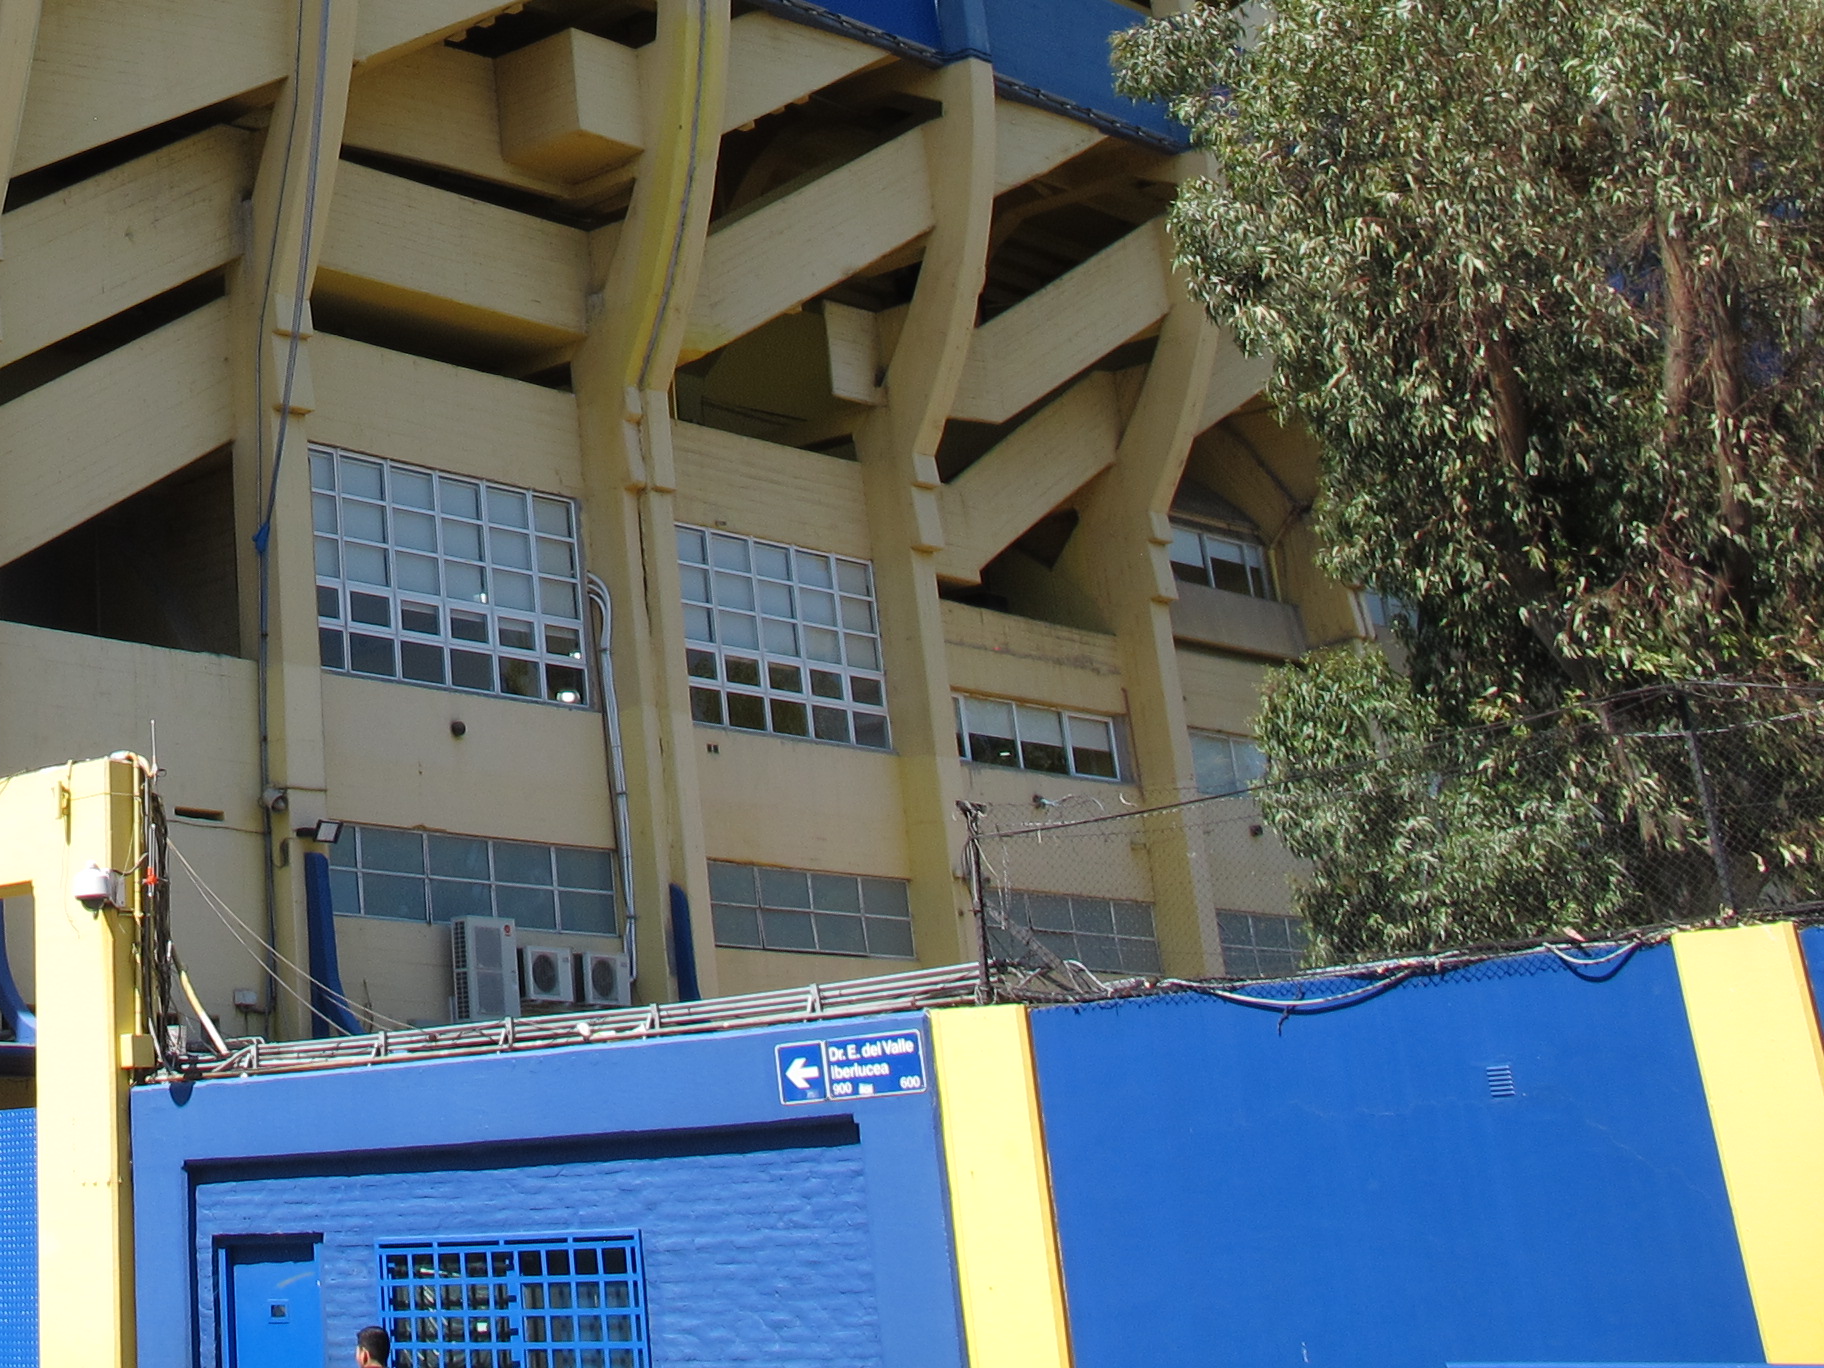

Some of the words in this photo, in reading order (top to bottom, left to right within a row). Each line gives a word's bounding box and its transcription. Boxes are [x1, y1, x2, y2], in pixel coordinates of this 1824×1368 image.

[828, 1046, 846, 1062] Dr.
[846, 1044, 860, 1060] E.
[861, 1042, 882, 1058] del
[882, 1038, 914, 1055] Valle
[831, 1062, 890, 1080] Iberlucea
[832, 1082, 852, 1096] 900
[899, 1075, 921, 1090] 600
